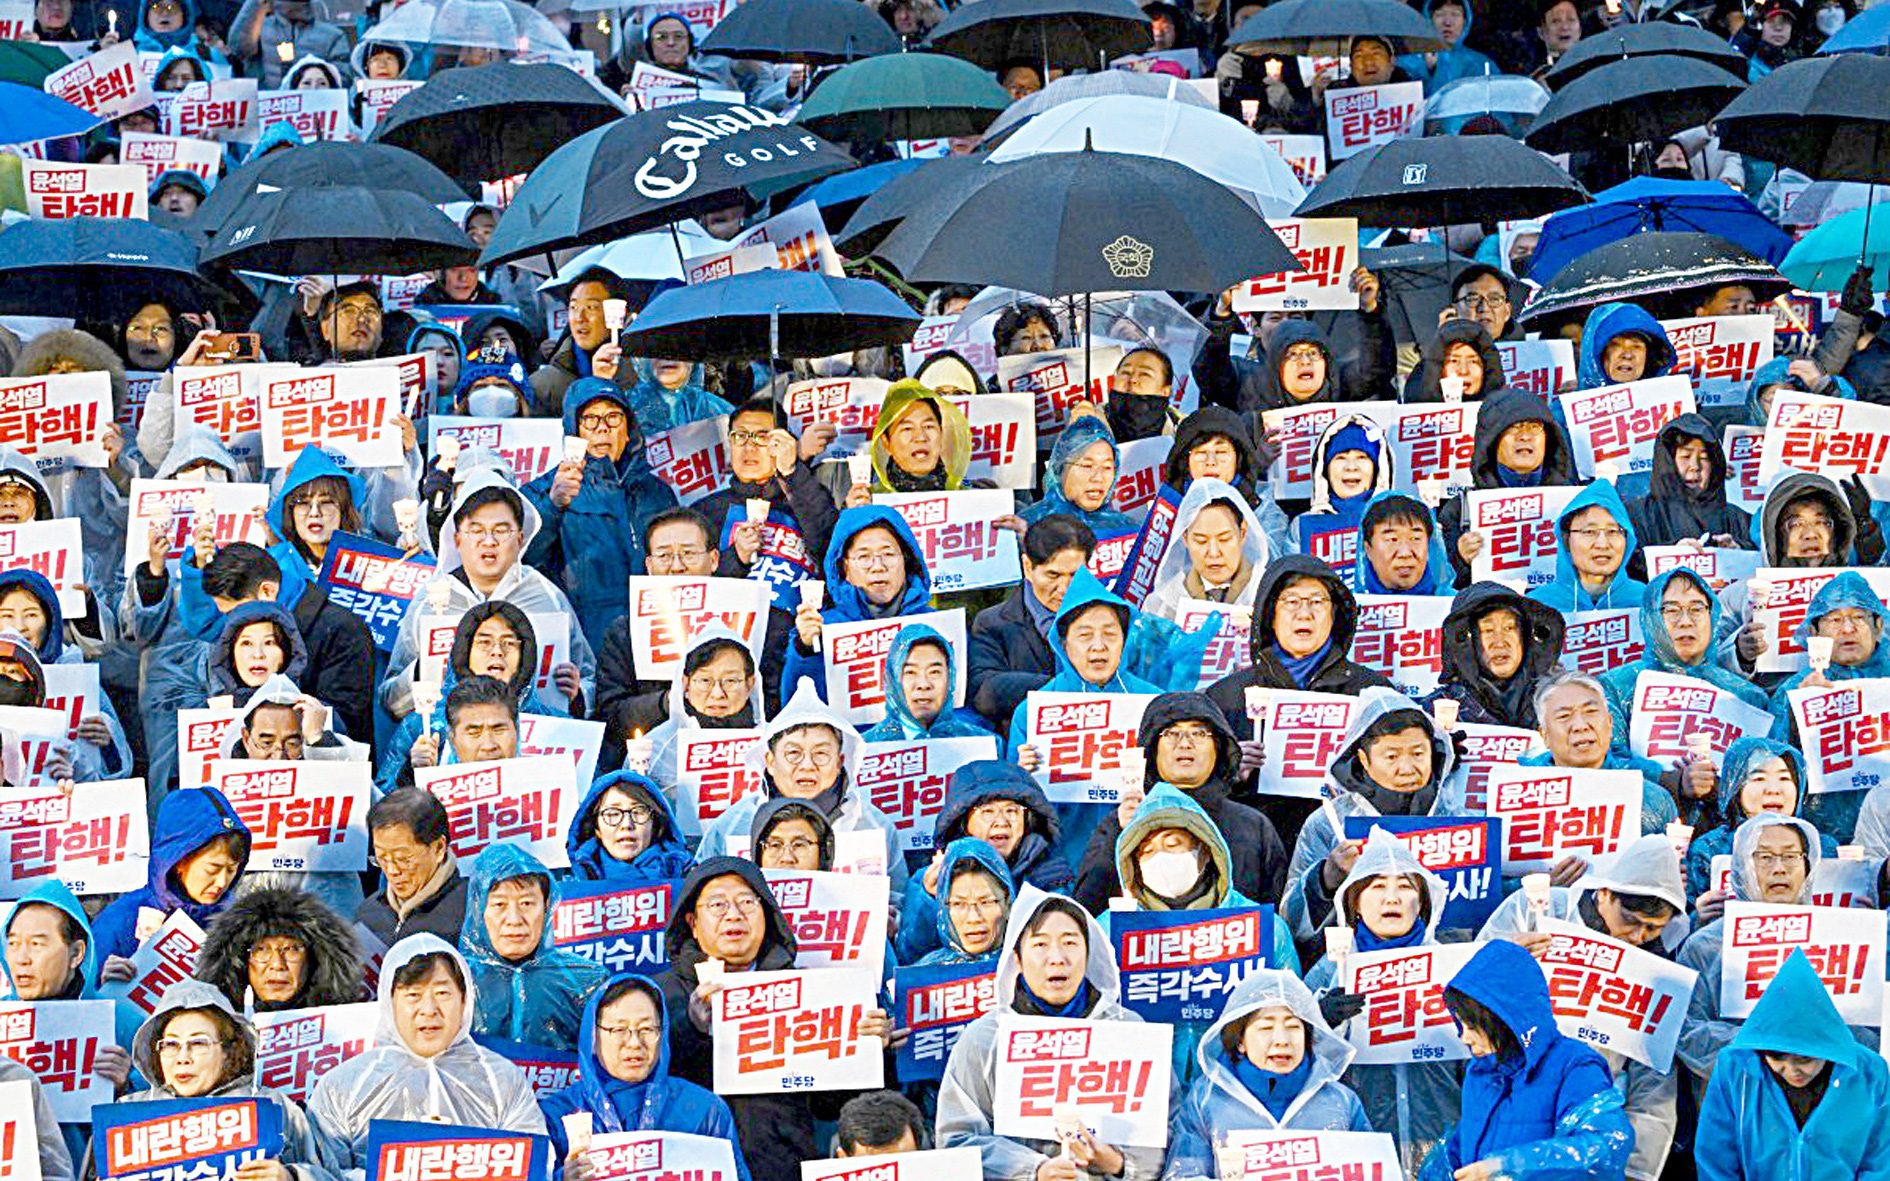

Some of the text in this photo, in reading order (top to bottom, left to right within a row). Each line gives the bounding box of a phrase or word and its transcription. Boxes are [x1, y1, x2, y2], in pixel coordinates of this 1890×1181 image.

[51, 62, 94, 92] 윤석열
[181, 101, 247, 136] 탄핵!
[1342, 104, 1413, 146] 탄핵!
[724, 136, 817, 167] GOLF
[33, 172, 84, 191] 윤석열
[1251, 246, 1345, 296] 핵!
[184, 374, 239, 403] 윤석열
[271, 378, 333, 405] 윤석열
[1573, 390, 1632, 422] 윤석열
[1778, 406, 1839, 428] 윤석열
[281, 398, 386, 452] 탄핵!
[1399, 410, 1461, 440] 윤석열
[968, 422, 1018, 467] 핵!
[1782, 433, 1888, 475] 탄핵!
[658, 443, 722, 496] 핵!
[1480, 496, 1541, 525] 윤석열
[1565, 618, 1628, 653] 윤석열
[1354, 629, 1442, 681] 탄핵
[1645, 686, 1716, 712] 윤석열
[1806, 691, 1862, 724] 윤석열
[1039, 703, 1108, 732] 윤석열
[1277, 704, 1348, 731] 윤석열
[1465, 737, 1530, 763] 윤석열
[861, 750, 925, 783] 윤석열
[1852, 773, 1880, 787] 민주당
[223, 770, 294, 798] 윤석열
[431, 771, 499, 800] 윤석열
[1087, 789, 1118, 800] 민주당
[1500, 779, 1570, 810] 윤석열
[0, 798, 68, 825] 윤석열
[239, 796, 354, 849] 탄핵!
[450, 789, 561, 858] 탄핵!
[10, 814, 129, 881] 탄핵!
[1508, 805, 1625, 861] 탄핵!
[272, 857, 304, 869] 민주당
[785, 909, 870, 962] 핵!
[1125, 917, 1255, 968] 내란행위
[1735, 915, 1810, 944] 윤석열
[1546, 939, 1623, 969] 윤석열
[1358, 957, 1430, 994] 윤석열
[727, 982, 800, 1020] 윤석열
[1181, 1005, 1215, 1019] 민주당
[1550, 968, 1673, 1034] 탄핵!
[258, 1017, 323, 1053] 윤석열
[738, 1004, 862, 1074] 탄핵!
[1012, 1031, 1088, 1060] 윤석열
[1578, 1027, 1610, 1045] 민주당
[8, 1037, 98, 1092] 핵!
[1411, 1046, 1444, 1060] 민주당
[781, 1075, 815, 1088] 민주당
[1020, 1060, 1152, 1117] 탄핵!
[114, 1107, 251, 1168] 내란행위
[385, 1142, 526, 1181] 내란행위
[588, 1142, 662, 1178] 윤석열
[1245, 1140, 1318, 1172] 윤석열
